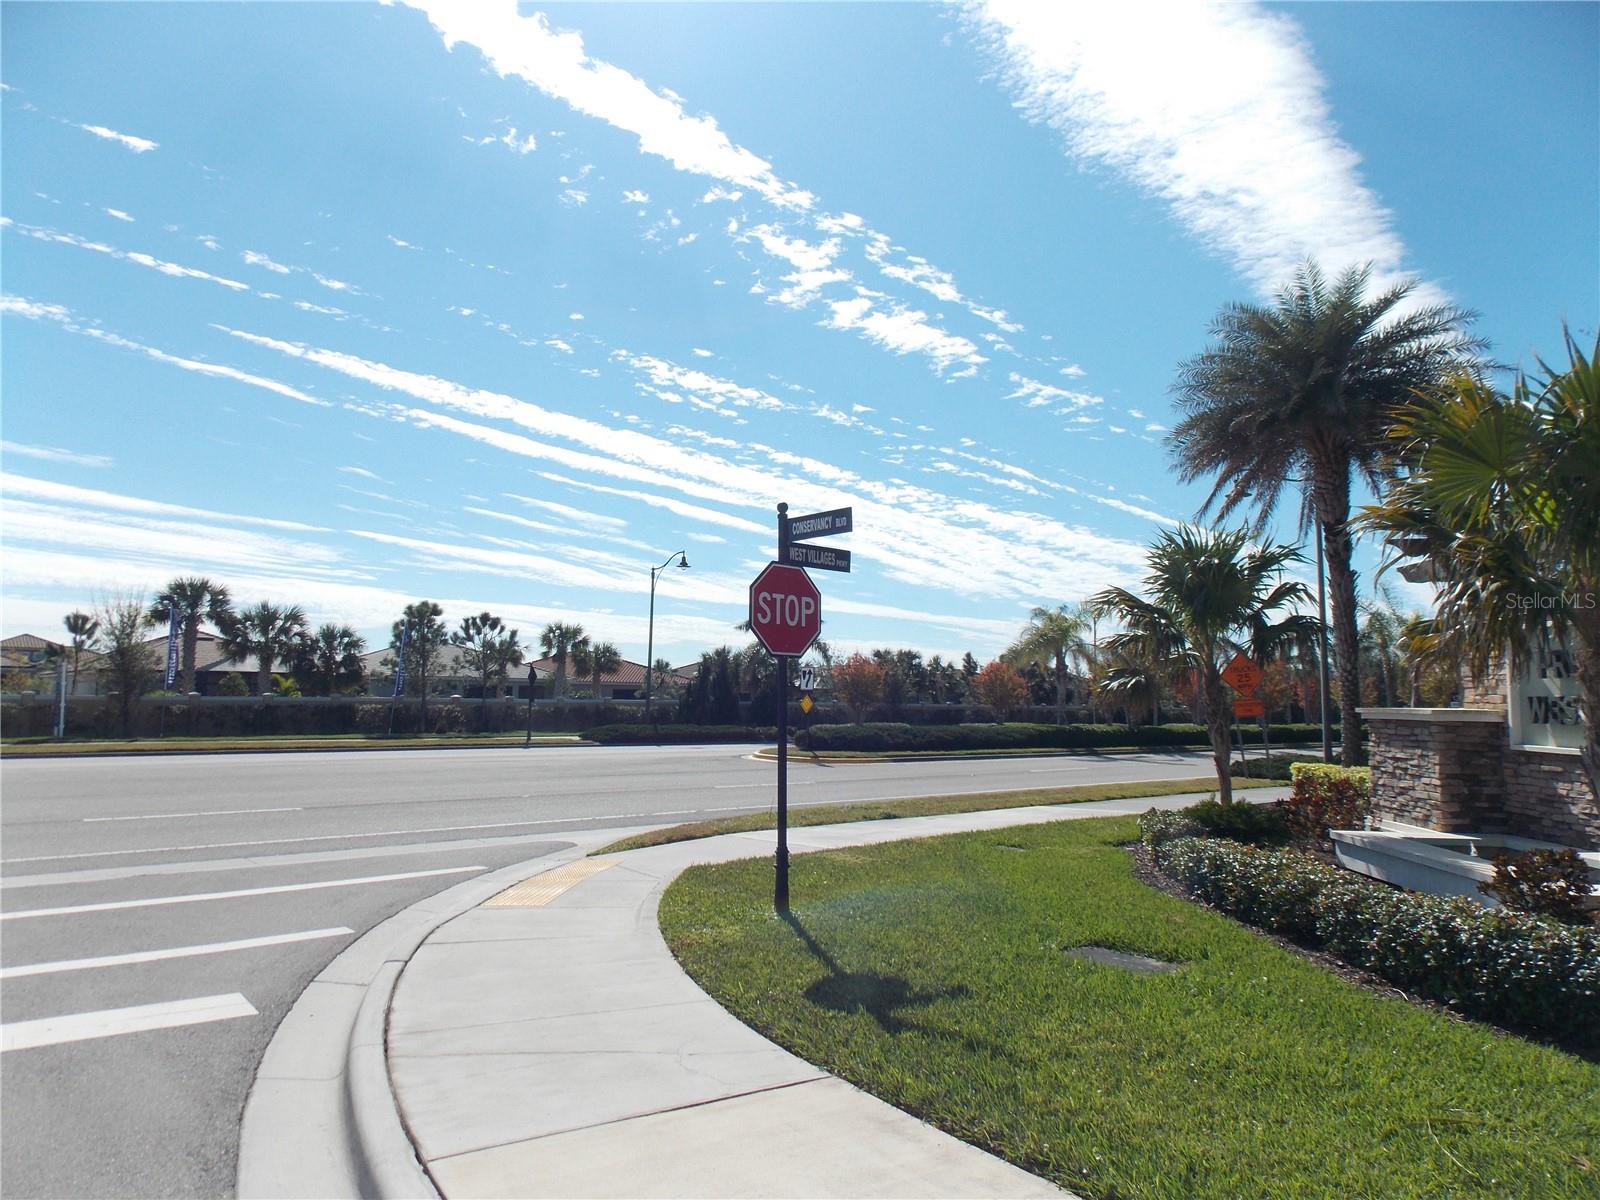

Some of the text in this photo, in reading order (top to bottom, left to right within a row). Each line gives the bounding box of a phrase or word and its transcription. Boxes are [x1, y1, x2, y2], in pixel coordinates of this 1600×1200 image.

[792, 516, 847, 535] CONSERVANCY BLVD
[789, 547, 807, 562] WEST
[807, 549, 836, 566] VILLAGES
[757, 591, 815, 627] STOP
